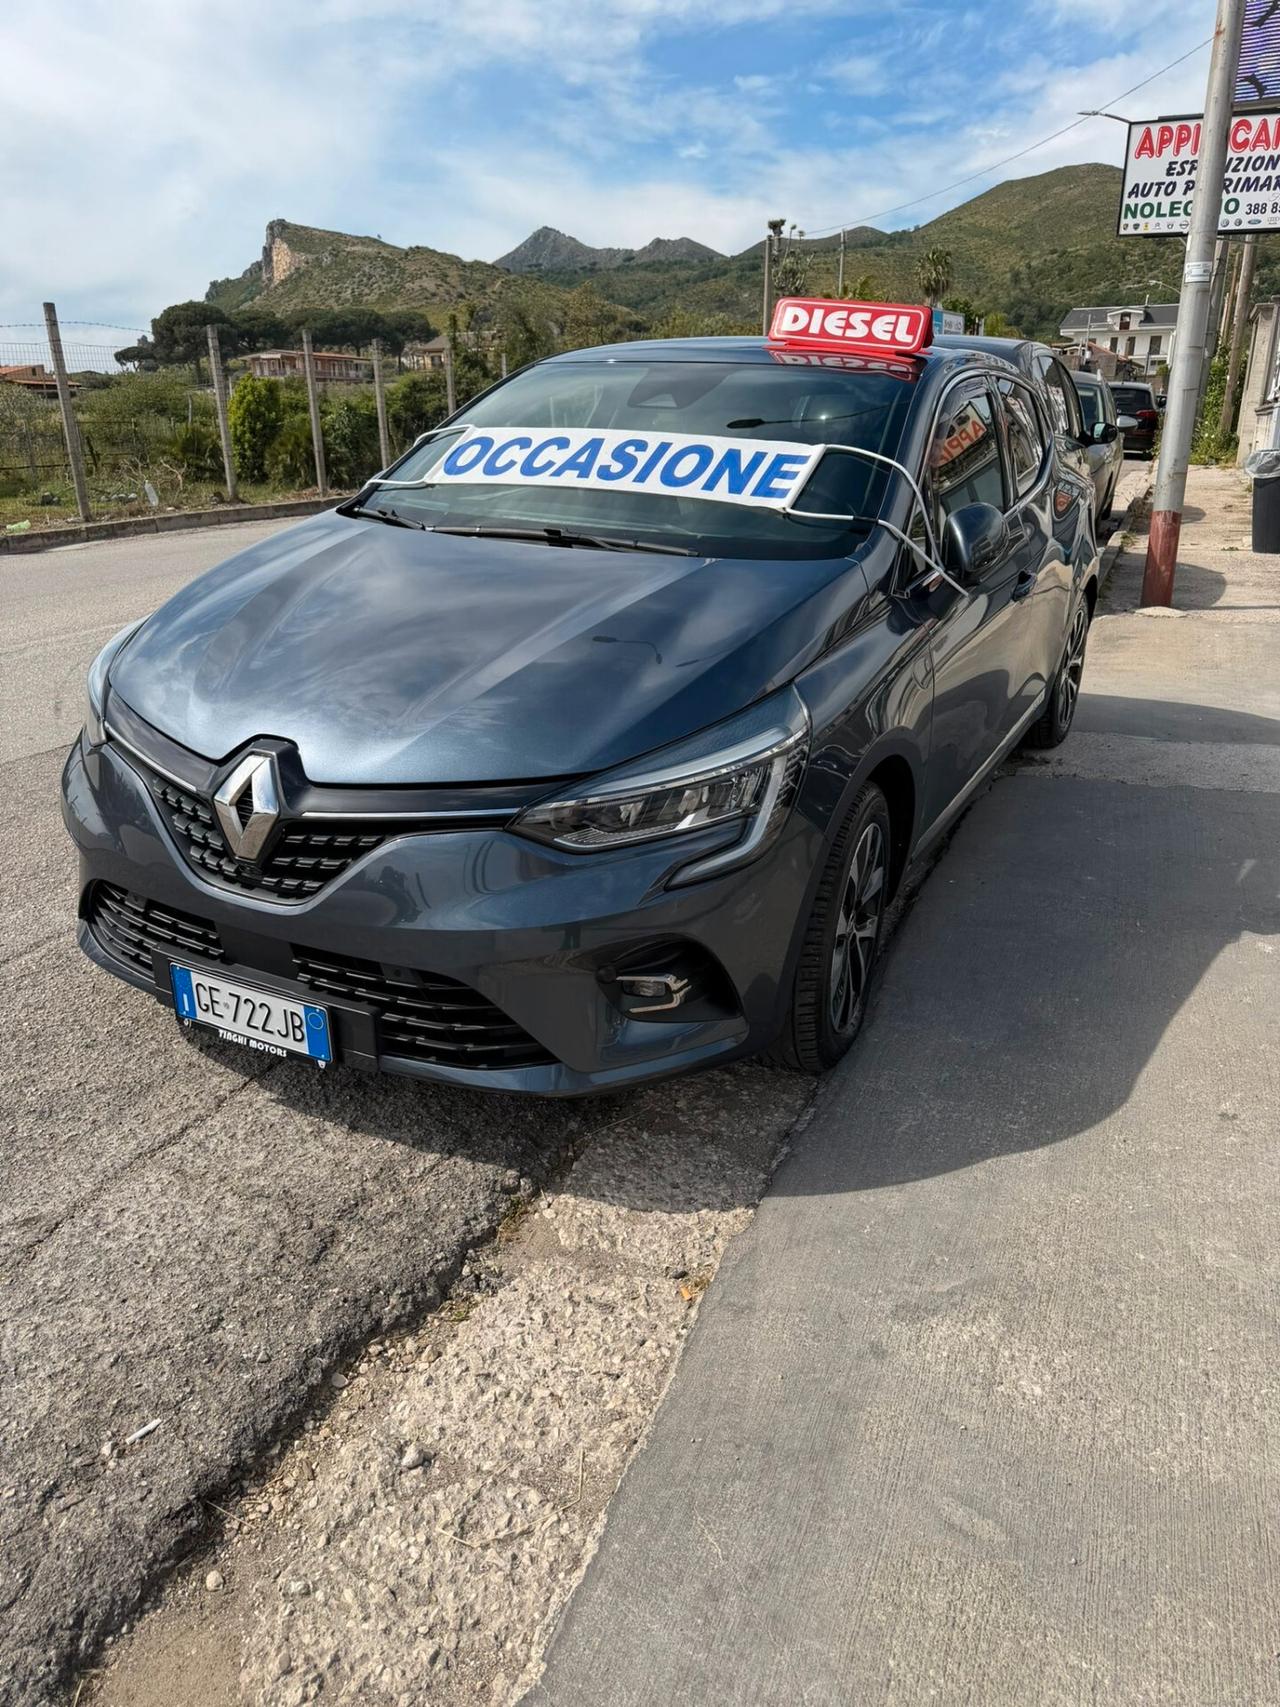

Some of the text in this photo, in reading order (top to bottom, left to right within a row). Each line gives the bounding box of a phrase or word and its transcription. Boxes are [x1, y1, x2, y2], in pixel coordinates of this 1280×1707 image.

[1134, 122, 1230, 160] APPI
[1127, 181, 1178, 199] AUTO
[1245, 202, 1268, 216] 388
[1270, 201, 1280, 214] 8
[780, 306, 915, 344] DIESEL
[443, 436, 812, 499] OCCASIONE
[218, 1029, 288, 1058] TINGHI MOTORS
